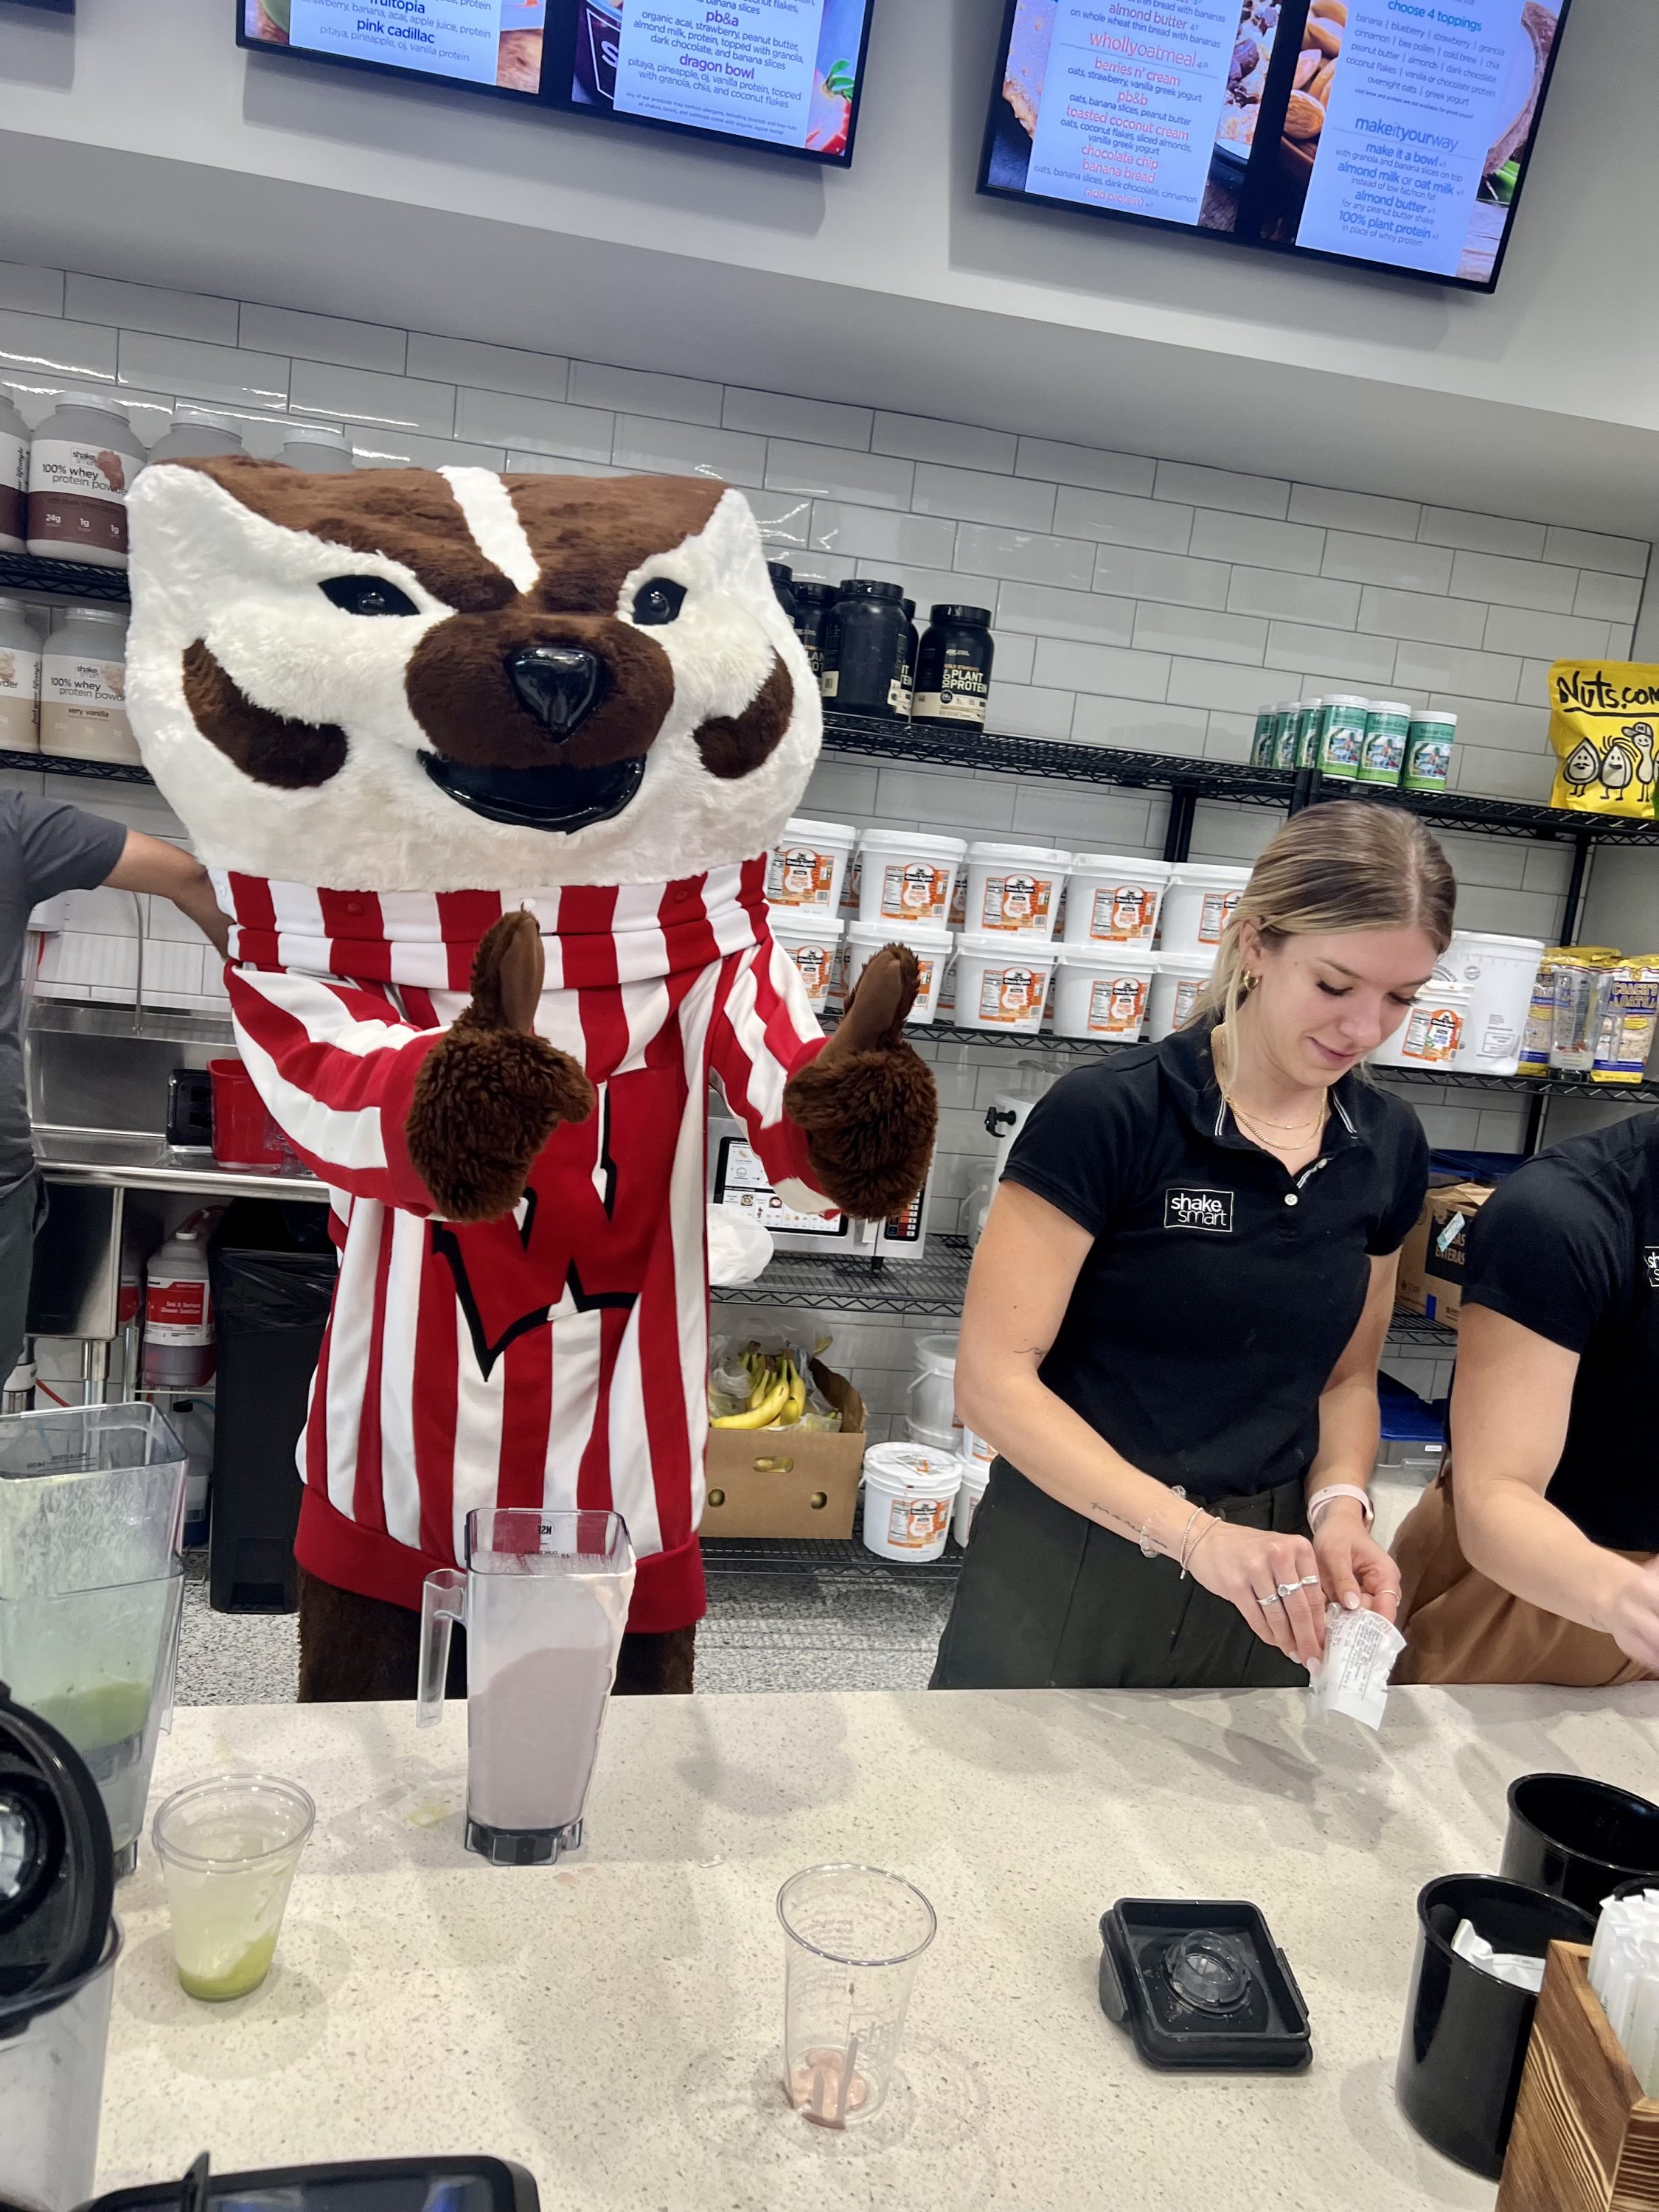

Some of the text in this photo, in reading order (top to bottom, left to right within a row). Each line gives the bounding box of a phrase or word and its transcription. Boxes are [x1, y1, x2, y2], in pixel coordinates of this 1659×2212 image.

[352, 4, 490, 38] banana, acai, apple juice, protein
[706, 10, 738, 26] pb&a
[1109, 2, 1187, 29] almond butter
[1388, 0, 1481, 31] choose 4 toppings
[357, 18, 434, 43] pink cadillac
[633, 20, 803, 63] almond milk, protein, topped with granola,
[641, 11, 798, 51] organic acai, strawberry, peanut butter,
[1082, 12, 1110, 23] whole
[1111, 17, 1130, 27] wheat
[1132, 21, 1146, 31] thin
[1148, 25, 1170, 36] bread
[1172, 32, 1187, 41] with
[1189, 34, 1220, 48] bananas
[320, 27, 348, 38] pitaya,
[351, 32, 395, 47] pineapple,
[409, 44, 437, 55] vanilla
[439, 49, 469, 61] protein
[650, 34, 785, 69] dark chocolate, and banana slices
[1090, 31, 1196, 67] whollyoatmeal
[627, 58, 801, 100] pitaya, pineapple, oj, vanilla protein, topped
[679, 53, 754, 79] dragon bowl
[1094, 56, 1180, 86] berries n' cream
[639, 71, 788, 108] with granola, chia, and coconut flakes
[1117, 90, 1147, 105] pb&b
[1130, 81, 1153, 91] vanilla
[1155, 86, 1175, 96] greek
[1177, 91, 1202, 102] yogurt
[1066, 105, 1189, 140] toasted coconut cream
[1088, 97, 1116, 109] banana
[1140, 110, 1166, 120] peanut
[1168, 114, 1191, 125] butter
[1080, 123, 1110, 135] coconut
[1136, 134, 1158, 144] sliced
[1088, 135, 1159, 155] vanilla greek yogurt
[1355, 118, 1458, 152] makeityourway
[1081, 144, 1158, 170] chocolate chip
[1366, 144, 1439, 166] make it a bowl
[1082, 158, 1155, 184] banana bread
[1338, 161, 1453, 195] almond milk or oat milk
[1054, 167, 1080, 180] banana
[1105, 178, 1121, 188] dark
[1161, 191, 1197, 203] cinnamon
[1355, 189, 1426, 212] almond butter
[1339, 210, 1430, 238] 100% plant protein
[72, 451, 96, 460] shake
[43, 464, 98, 481] 100% whey
[52, 475, 88, 487] protein
[46, 514, 119, 535] 24g 1g 1g
[77, 665, 97, 673] shake
[951, 669, 984, 682] PLANT
[51, 677, 100, 692] 100% whey
[59, 688, 92, 698] protein
[1171, 1193, 1222, 1212] shake
[1178, 1210, 1227, 1225] smart
